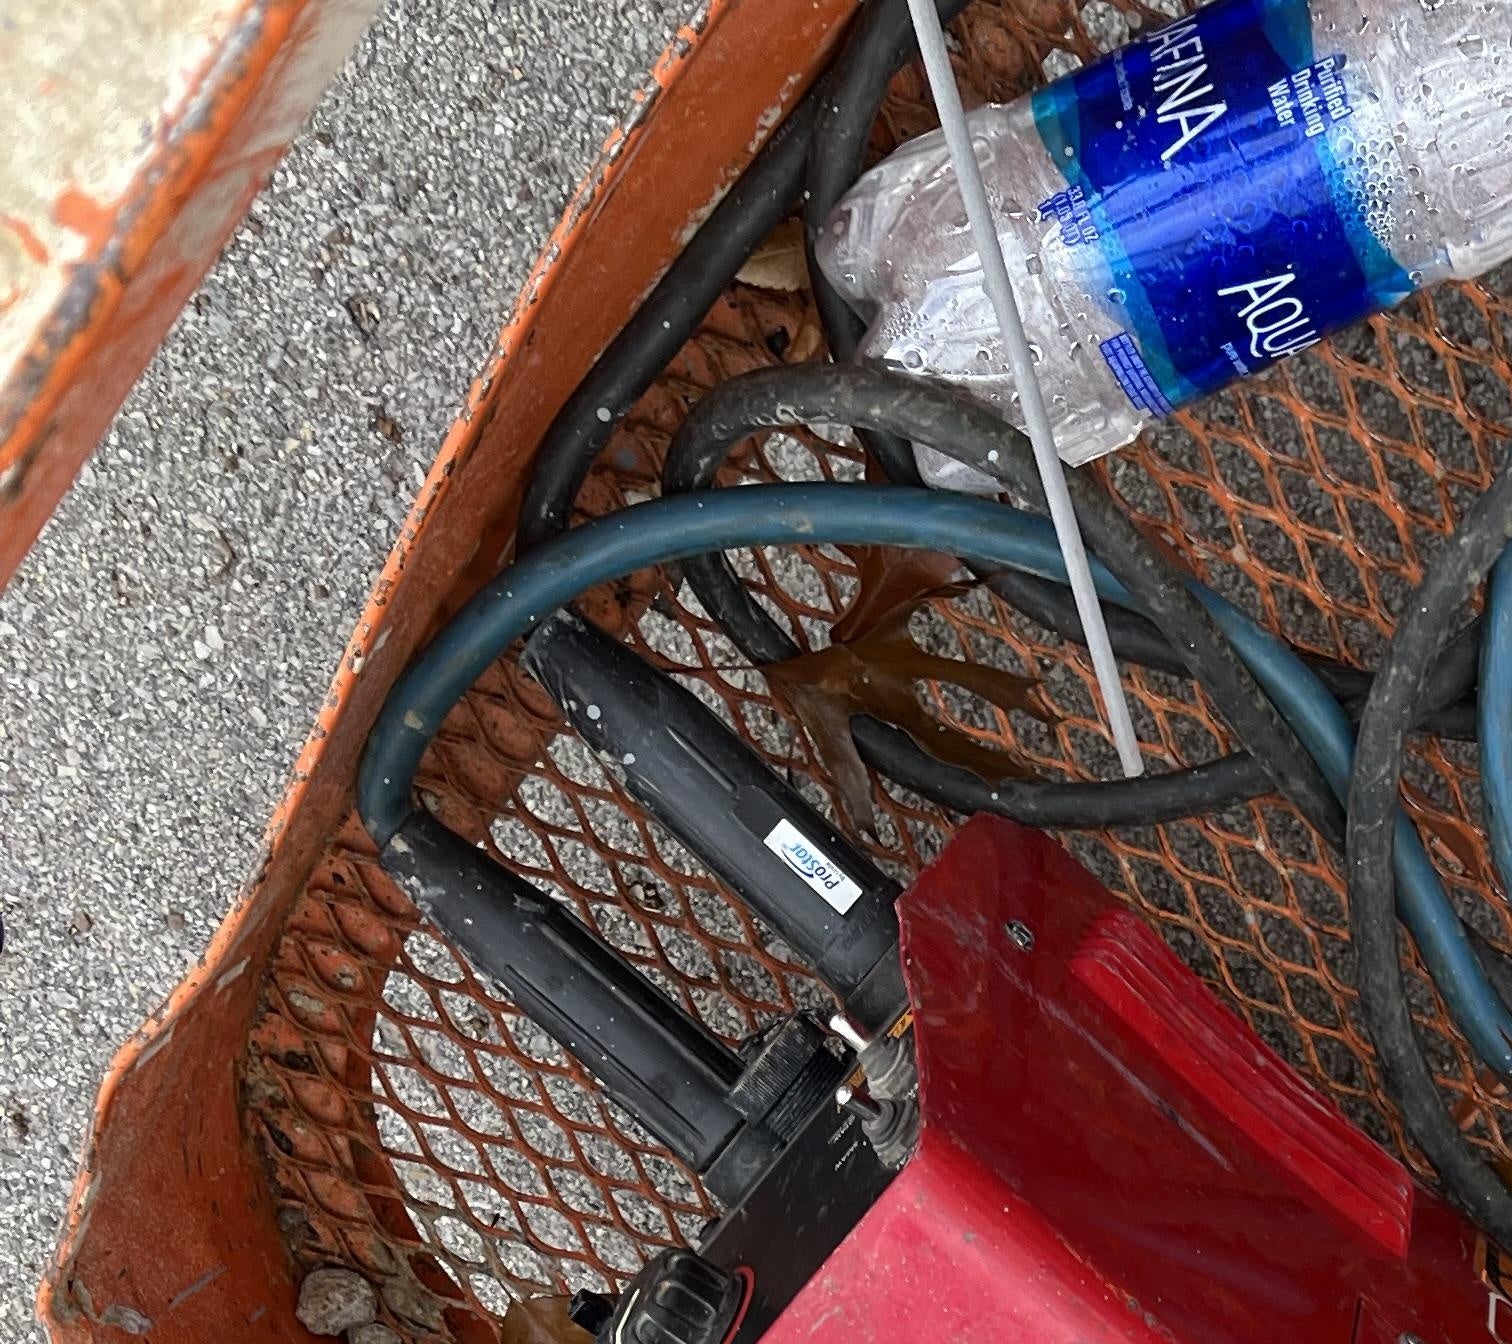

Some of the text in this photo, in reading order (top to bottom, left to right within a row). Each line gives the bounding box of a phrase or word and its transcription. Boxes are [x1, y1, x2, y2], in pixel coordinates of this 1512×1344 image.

[1267, 77, 1296, 128] Water
[1290, 68, 1326, 138] Drinking
[1313, 57, 1353, 121] Purified
[1074, 209, 1092, 225] FL
[1080, 224, 1099, 243] OZ
[790, 843, 839, 889] ProStar
